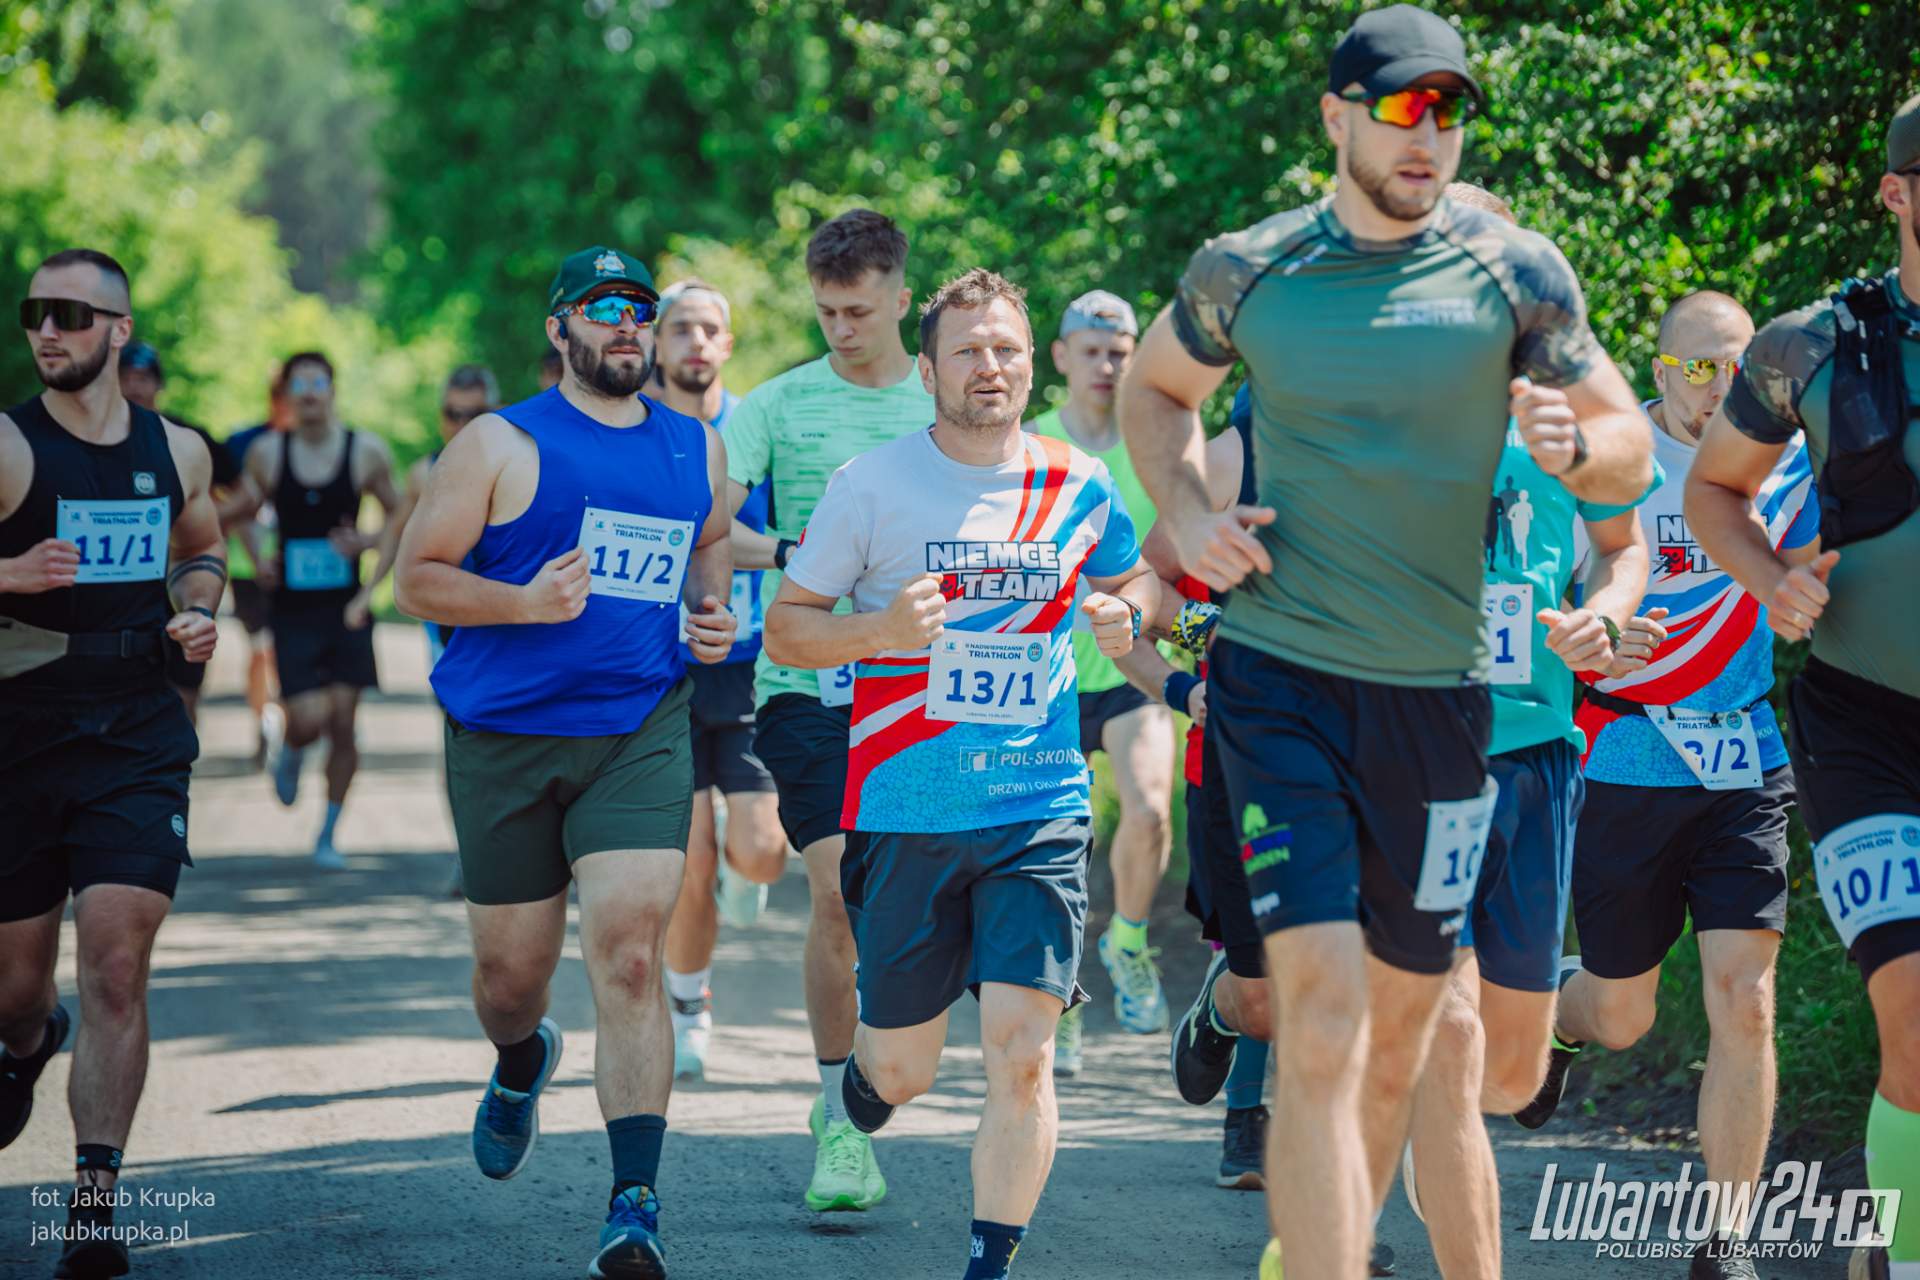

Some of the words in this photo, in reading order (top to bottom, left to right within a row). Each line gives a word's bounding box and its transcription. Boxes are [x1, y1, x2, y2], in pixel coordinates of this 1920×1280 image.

[75, 533, 155, 567] 11/1
[615, 529, 662, 542] TRIATHLON
[589, 545, 674, 585] 11/2
[926, 541, 1060, 572] NIEMCE
[962, 572, 1060, 602] TEAM
[968, 649, 1022, 660] TRIATHLON
[945, 668, 1037, 708] 13/1
[987, 782, 1026, 796] DRZWI
[1832, 856, 1920, 920] 10/1
